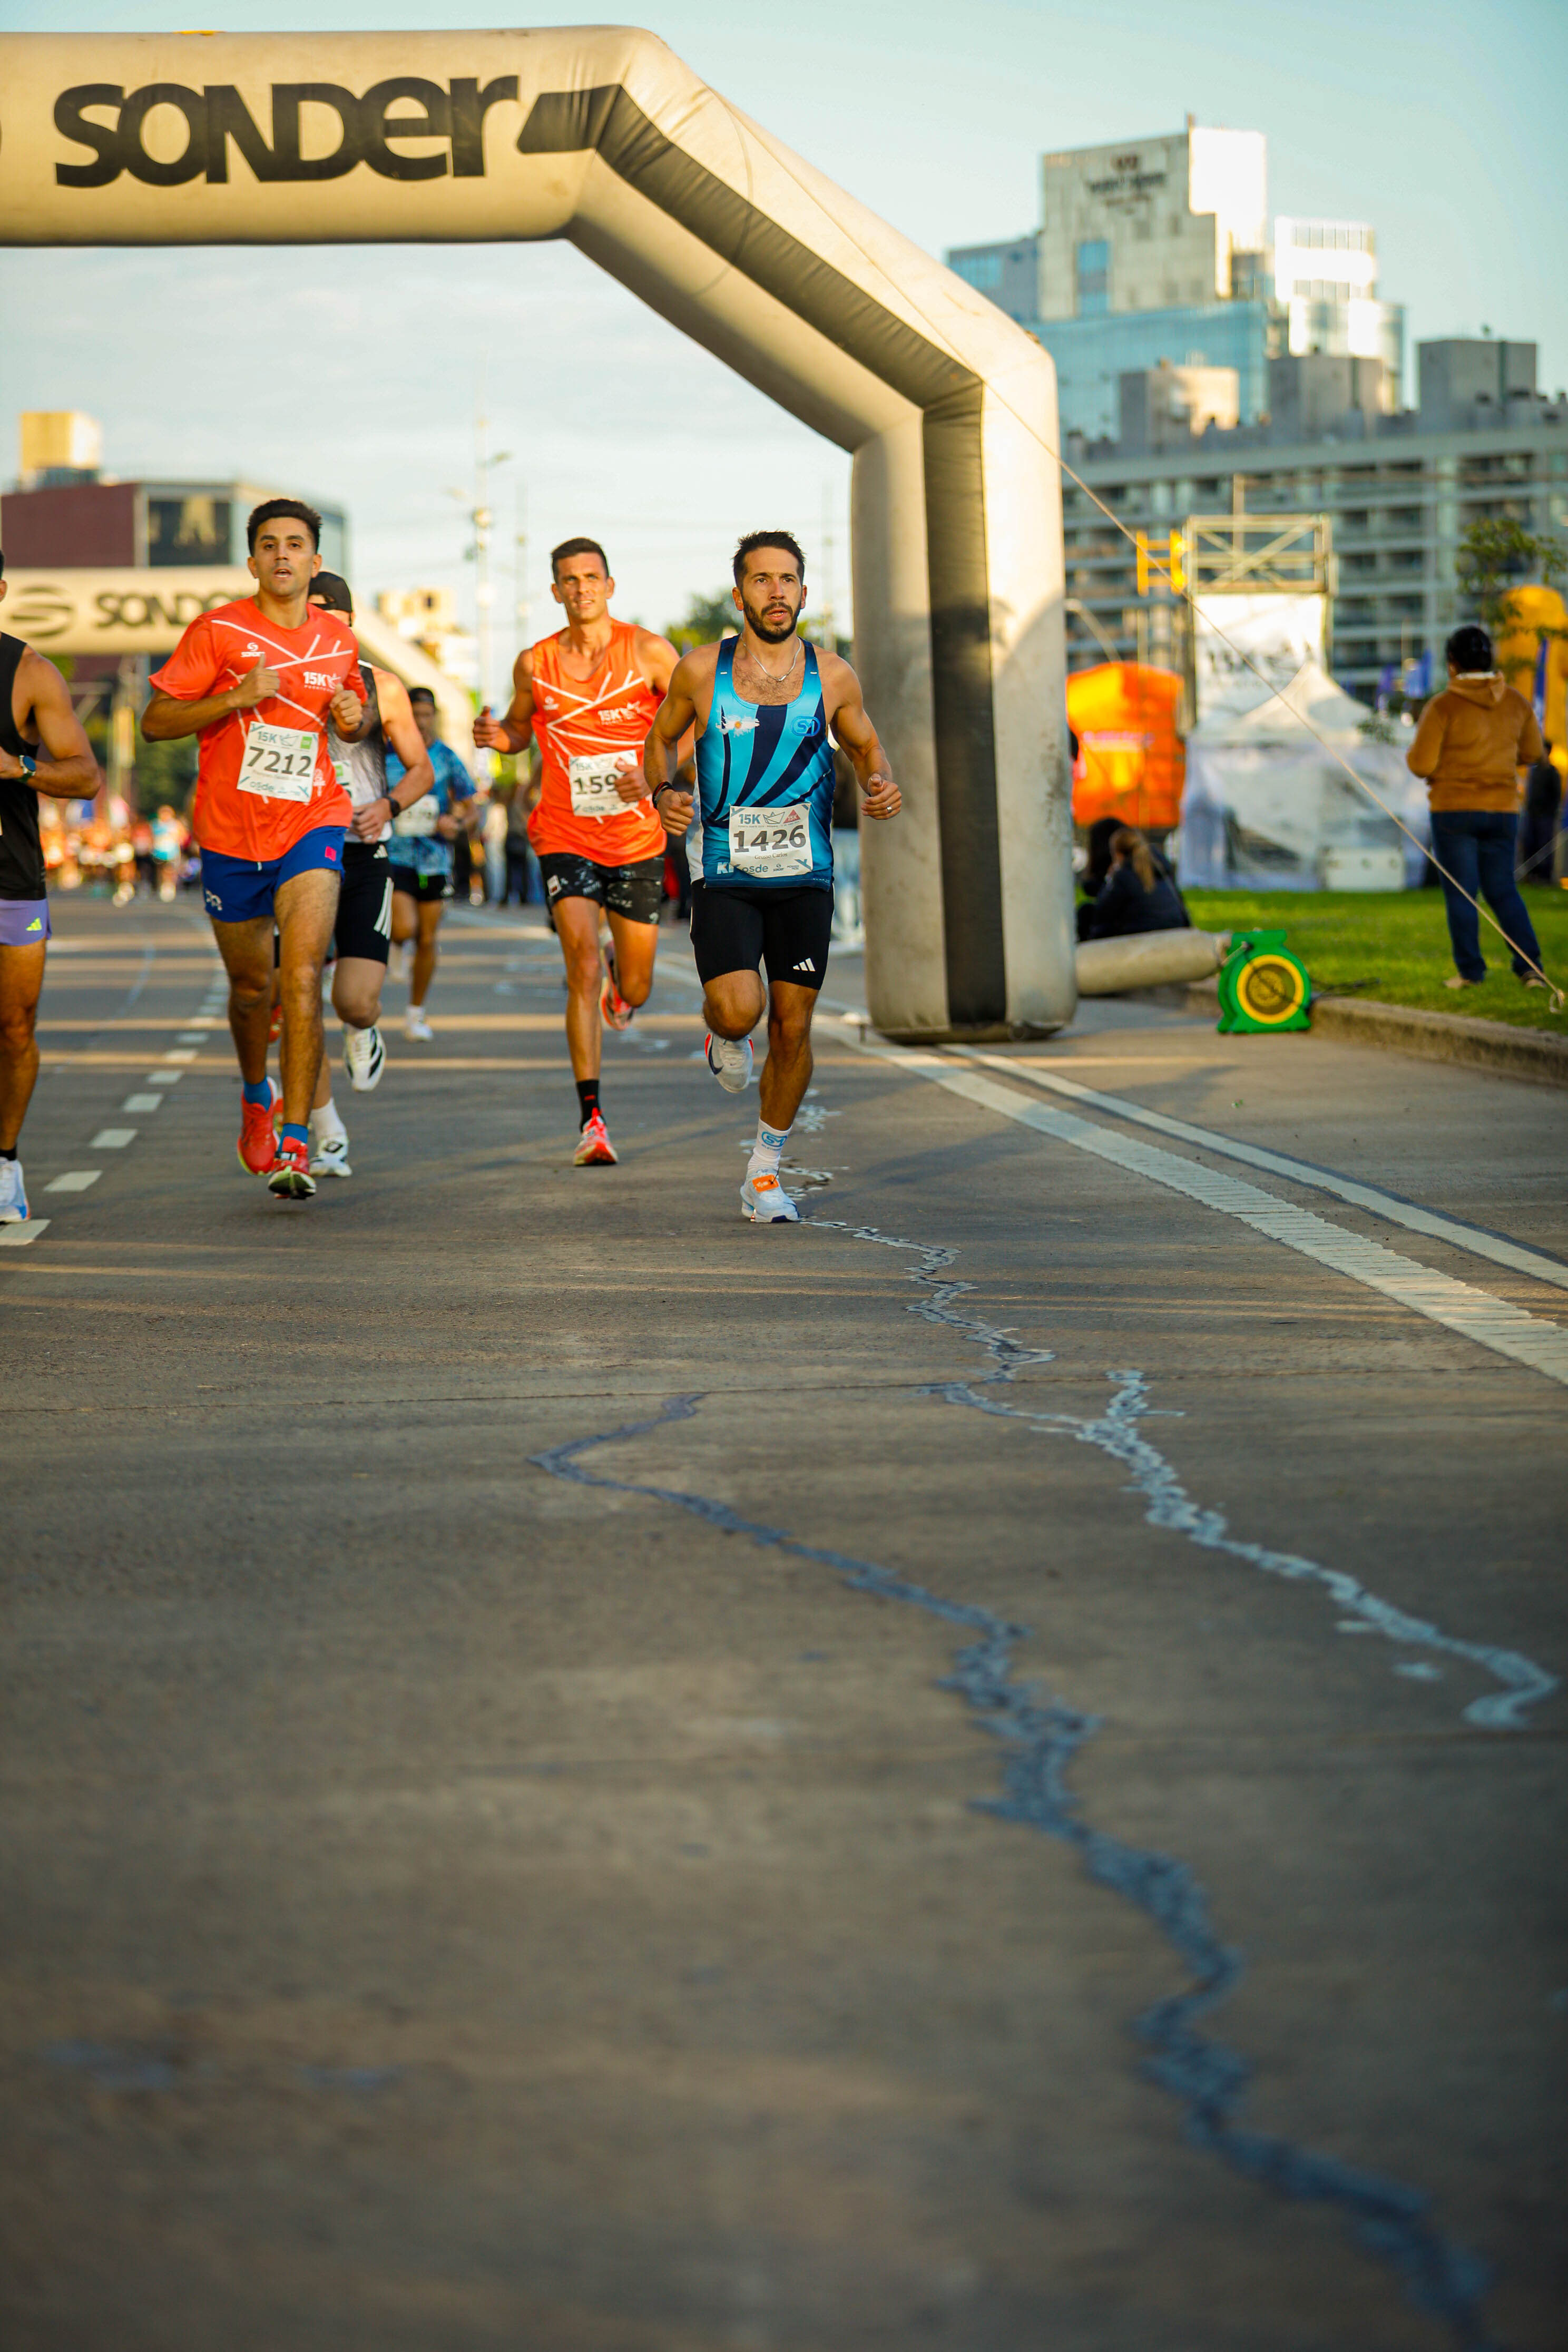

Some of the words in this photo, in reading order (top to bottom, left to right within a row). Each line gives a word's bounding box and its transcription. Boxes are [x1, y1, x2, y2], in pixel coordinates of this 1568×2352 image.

[95, 592, 252, 627] SOND
[303, 672, 326, 687] 15K
[258, 731, 277, 743] 15K
[247, 746, 311, 777] 7212
[573, 772, 628, 794] 159
[739, 814, 761, 825] 15K
[733, 825, 806, 853] 1426
[742, 864, 769, 874] osde
